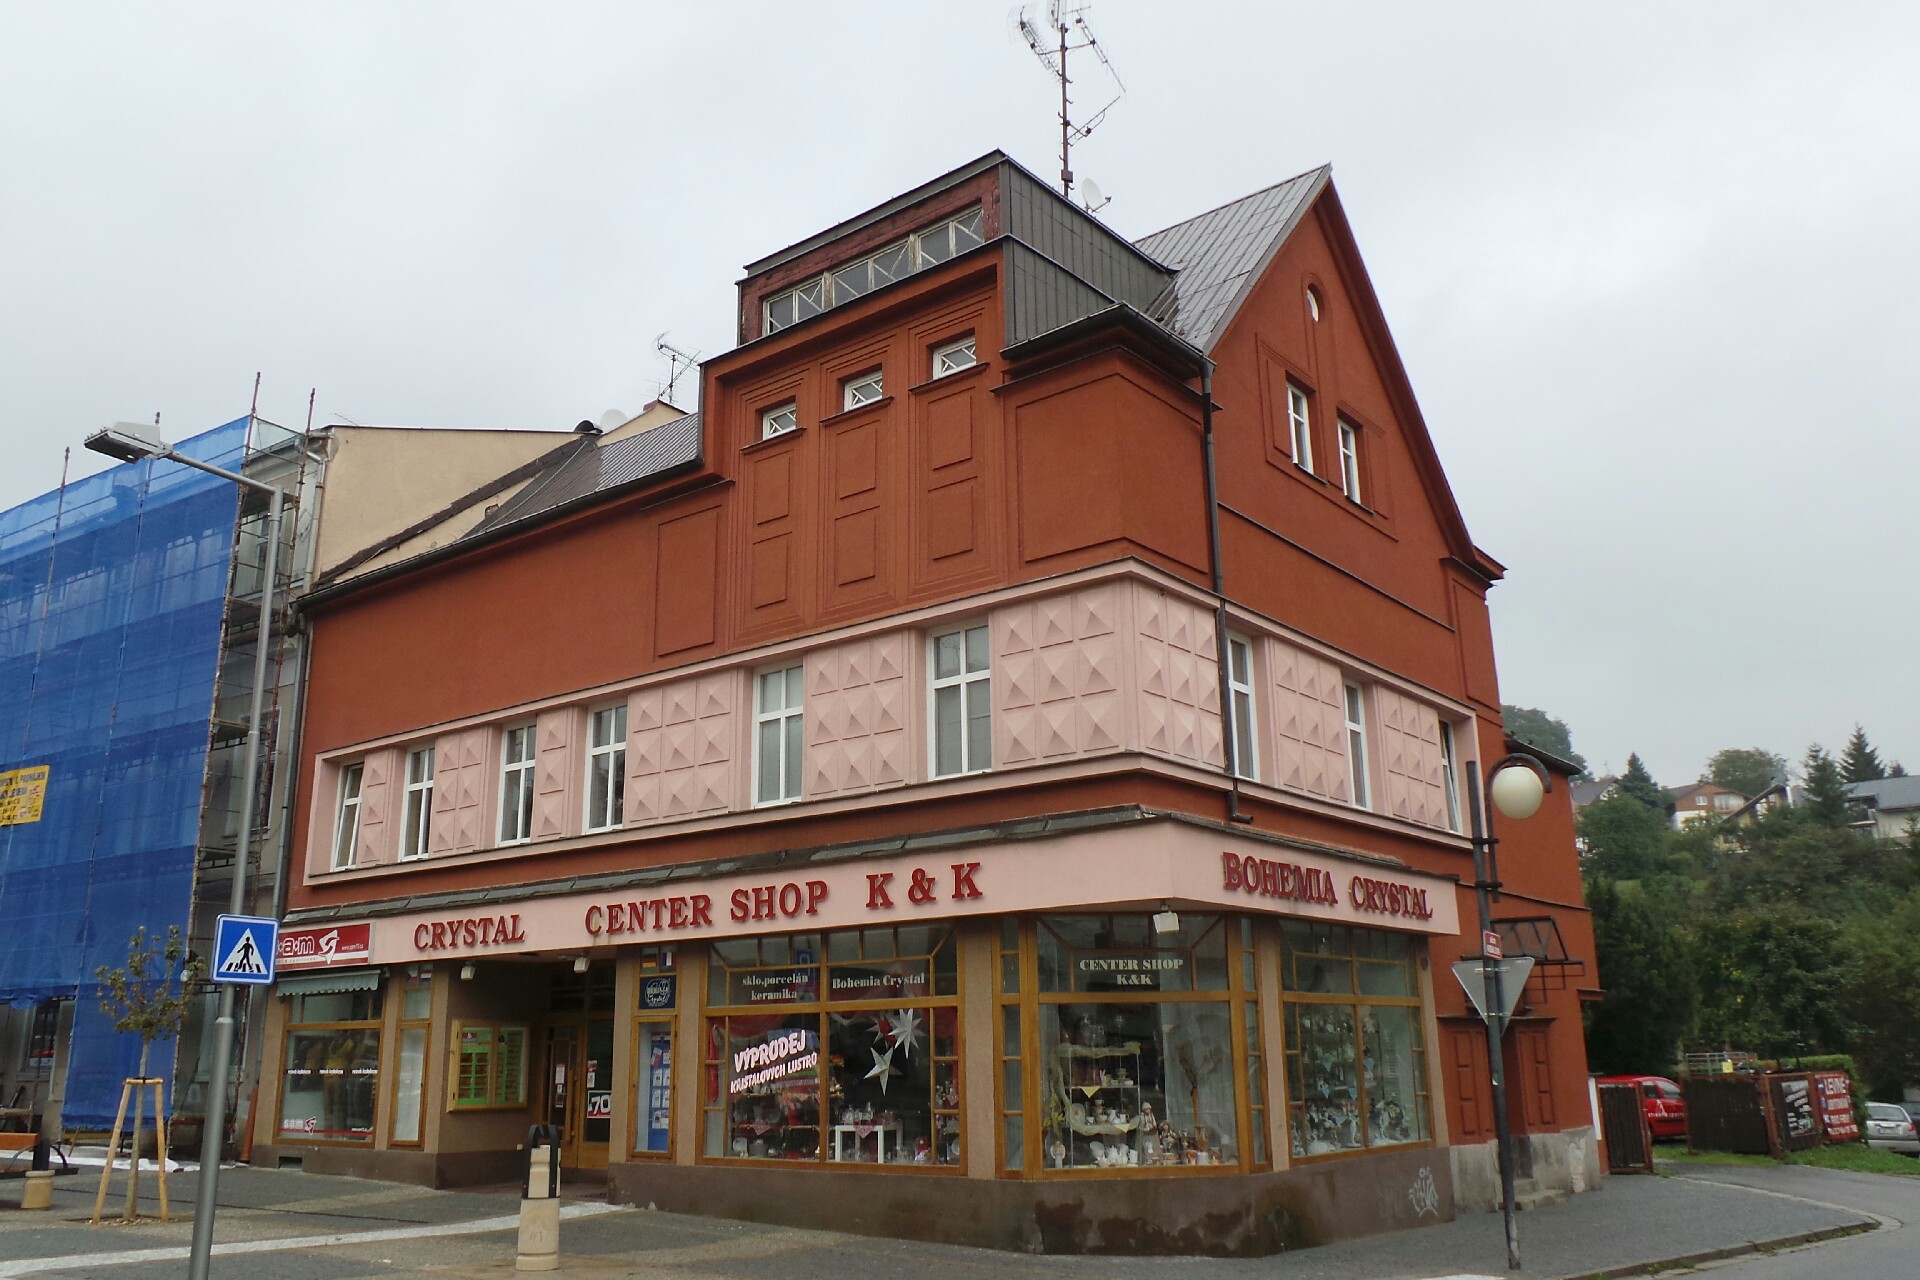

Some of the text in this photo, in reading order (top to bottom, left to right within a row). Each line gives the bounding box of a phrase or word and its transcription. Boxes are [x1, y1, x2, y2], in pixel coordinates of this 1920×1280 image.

[1222, 851, 1433, 920] BOHEMIA CRYSTAL
[413, 862, 983, 951] CRYSTAL CENTER SHOP K & K
[1079, 959, 1184, 971] CENTER SHOP
[832, 972, 925, 989] Bohemia Crystal
[1117, 974, 1153, 986] K&K
[751, 988, 798, 1001] keramika
[734, 1029, 806, 1073] VÝPRODEJ
